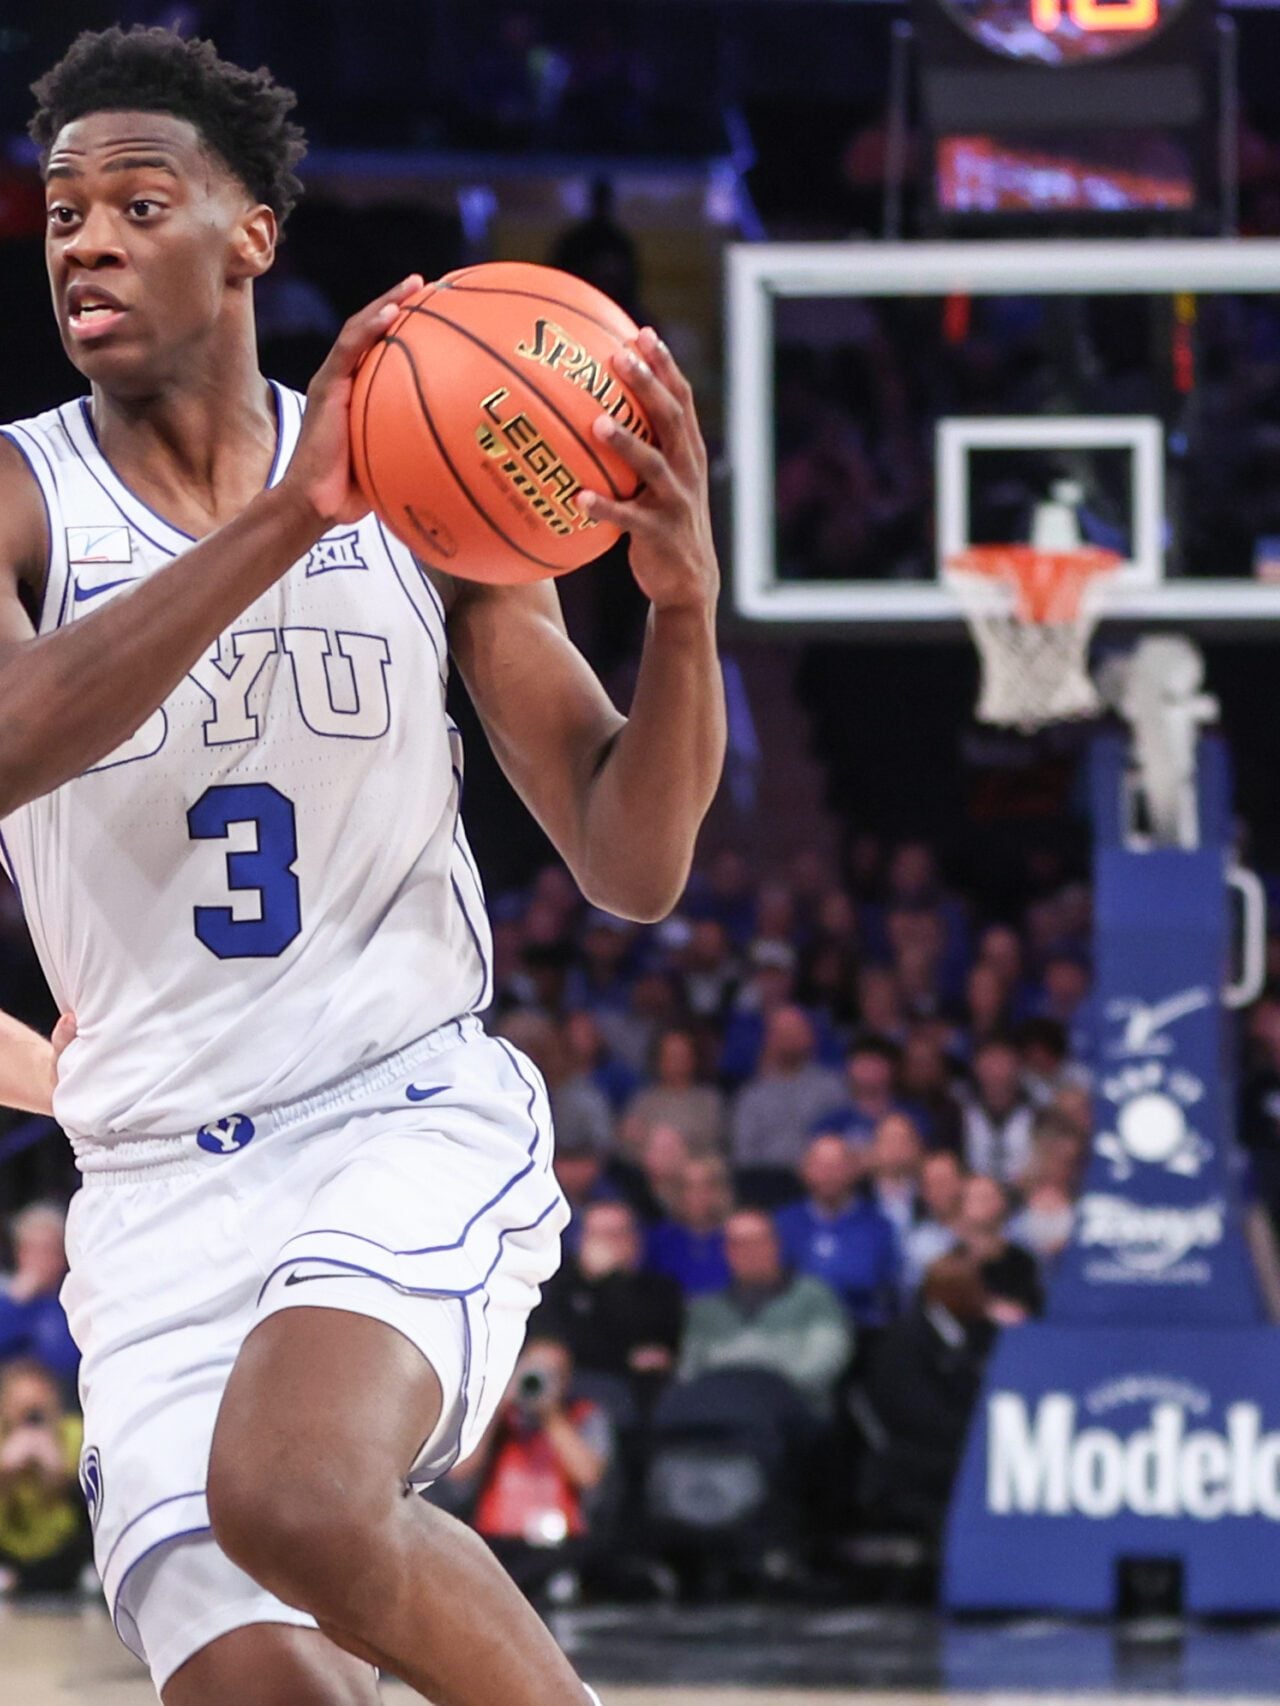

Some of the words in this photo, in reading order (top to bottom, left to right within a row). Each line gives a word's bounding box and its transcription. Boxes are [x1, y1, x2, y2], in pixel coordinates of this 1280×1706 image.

[515, 317, 658, 444] SPALDI
[82, 626, 392, 775] YU
[186, 781, 302, 960] 3
[202, 1115, 242, 1152] Y
